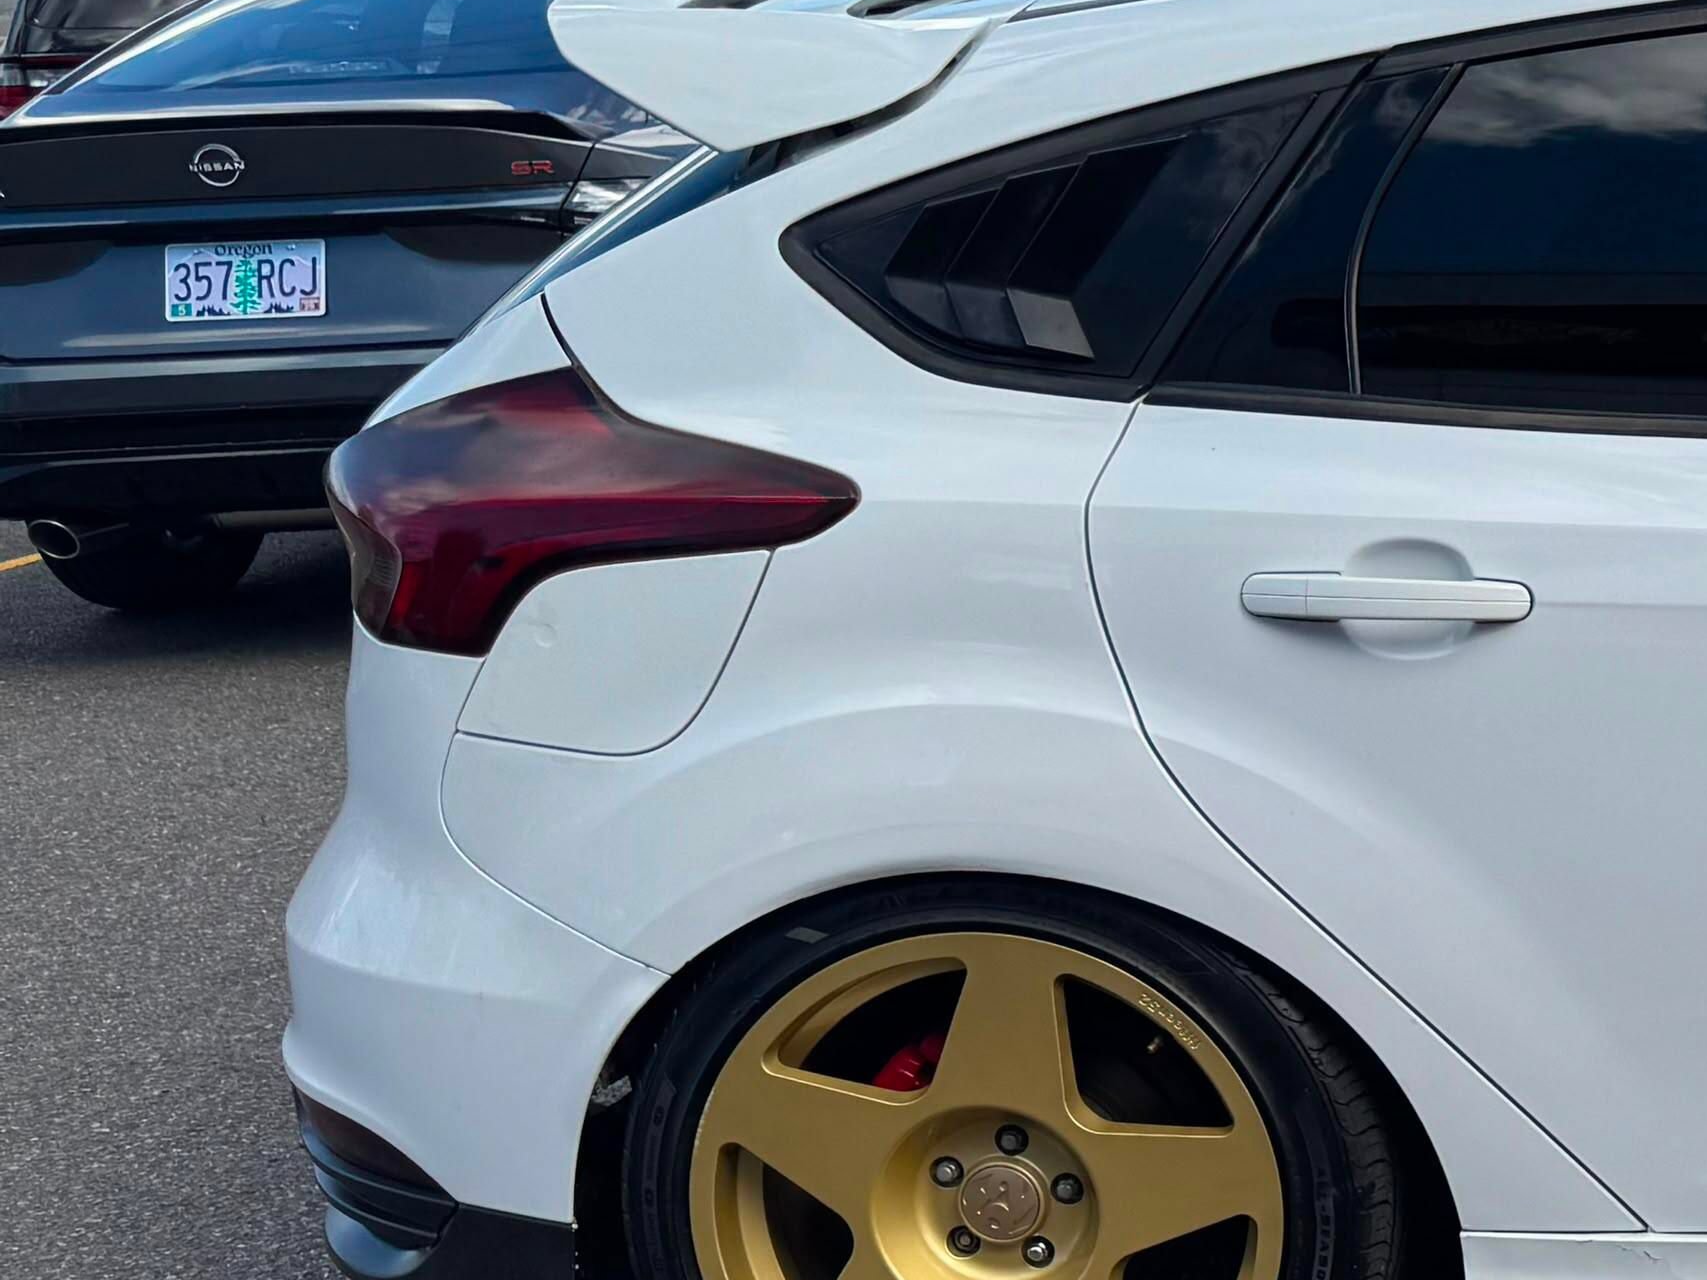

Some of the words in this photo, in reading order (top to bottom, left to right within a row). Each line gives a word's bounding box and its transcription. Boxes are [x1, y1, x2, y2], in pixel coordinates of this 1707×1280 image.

[188, 159, 246, 173] NISSAN
[510, 160, 555, 176] SR
[214, 242, 273, 259] Oregon
[174, 262, 233, 302] 357
[257, 256, 317, 299] RCJ
